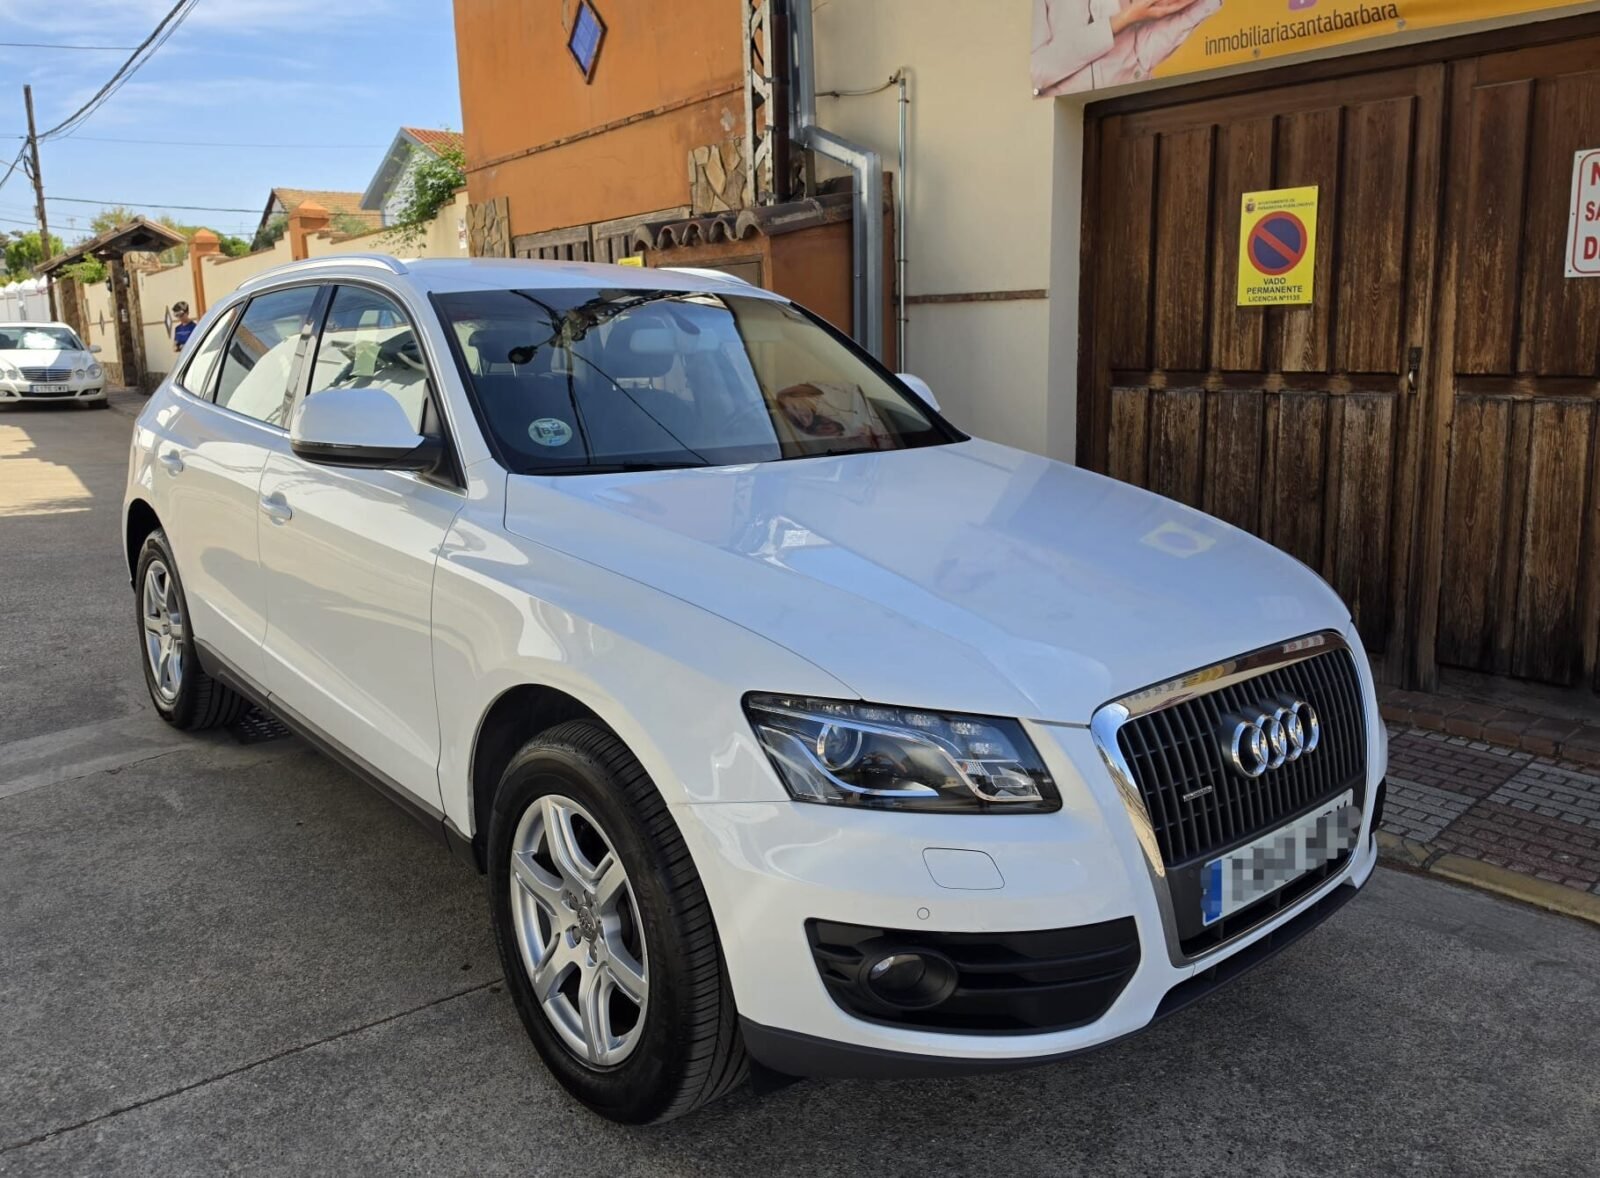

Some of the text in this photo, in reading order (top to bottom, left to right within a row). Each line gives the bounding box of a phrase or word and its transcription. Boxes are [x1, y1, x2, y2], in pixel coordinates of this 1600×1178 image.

[1205, 3, 1399, 56] inmobiliariasantabarbara
[1584, 236, 1600, 260] D
[1263, 277, 1286, 285] VADO
[1247, 285, 1303, 294] PERMANENTE
